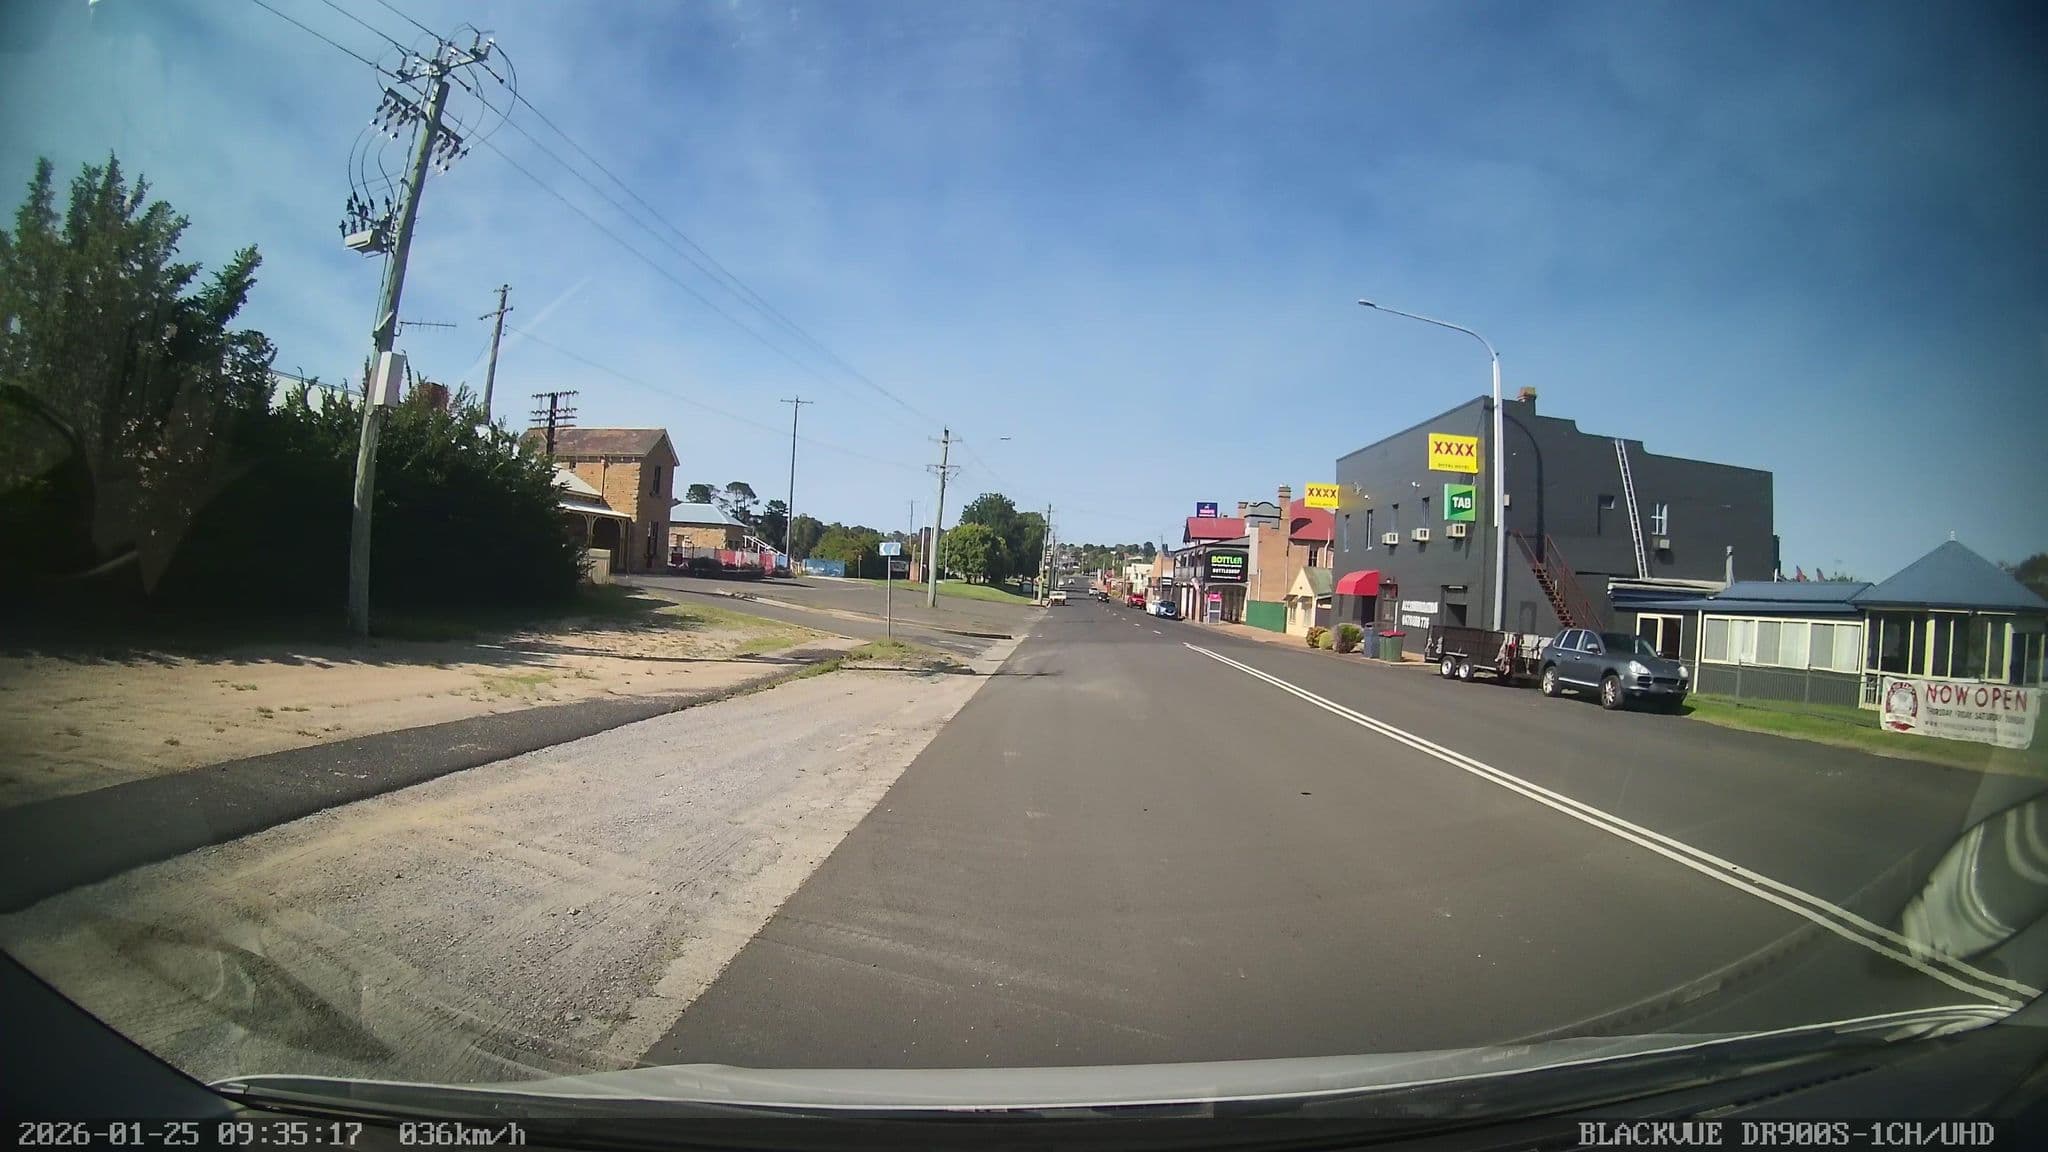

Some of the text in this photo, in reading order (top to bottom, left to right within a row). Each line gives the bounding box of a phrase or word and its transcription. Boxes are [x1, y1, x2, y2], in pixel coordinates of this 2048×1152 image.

[1434, 441, 1474, 457] XXXX
[1308, 488, 1336, 499] XXXX
[1452, 496, 1471, 509] TAB
[1926, 684, 1970, 706] NOW
[1975, 687, 2028, 712] OPEN
